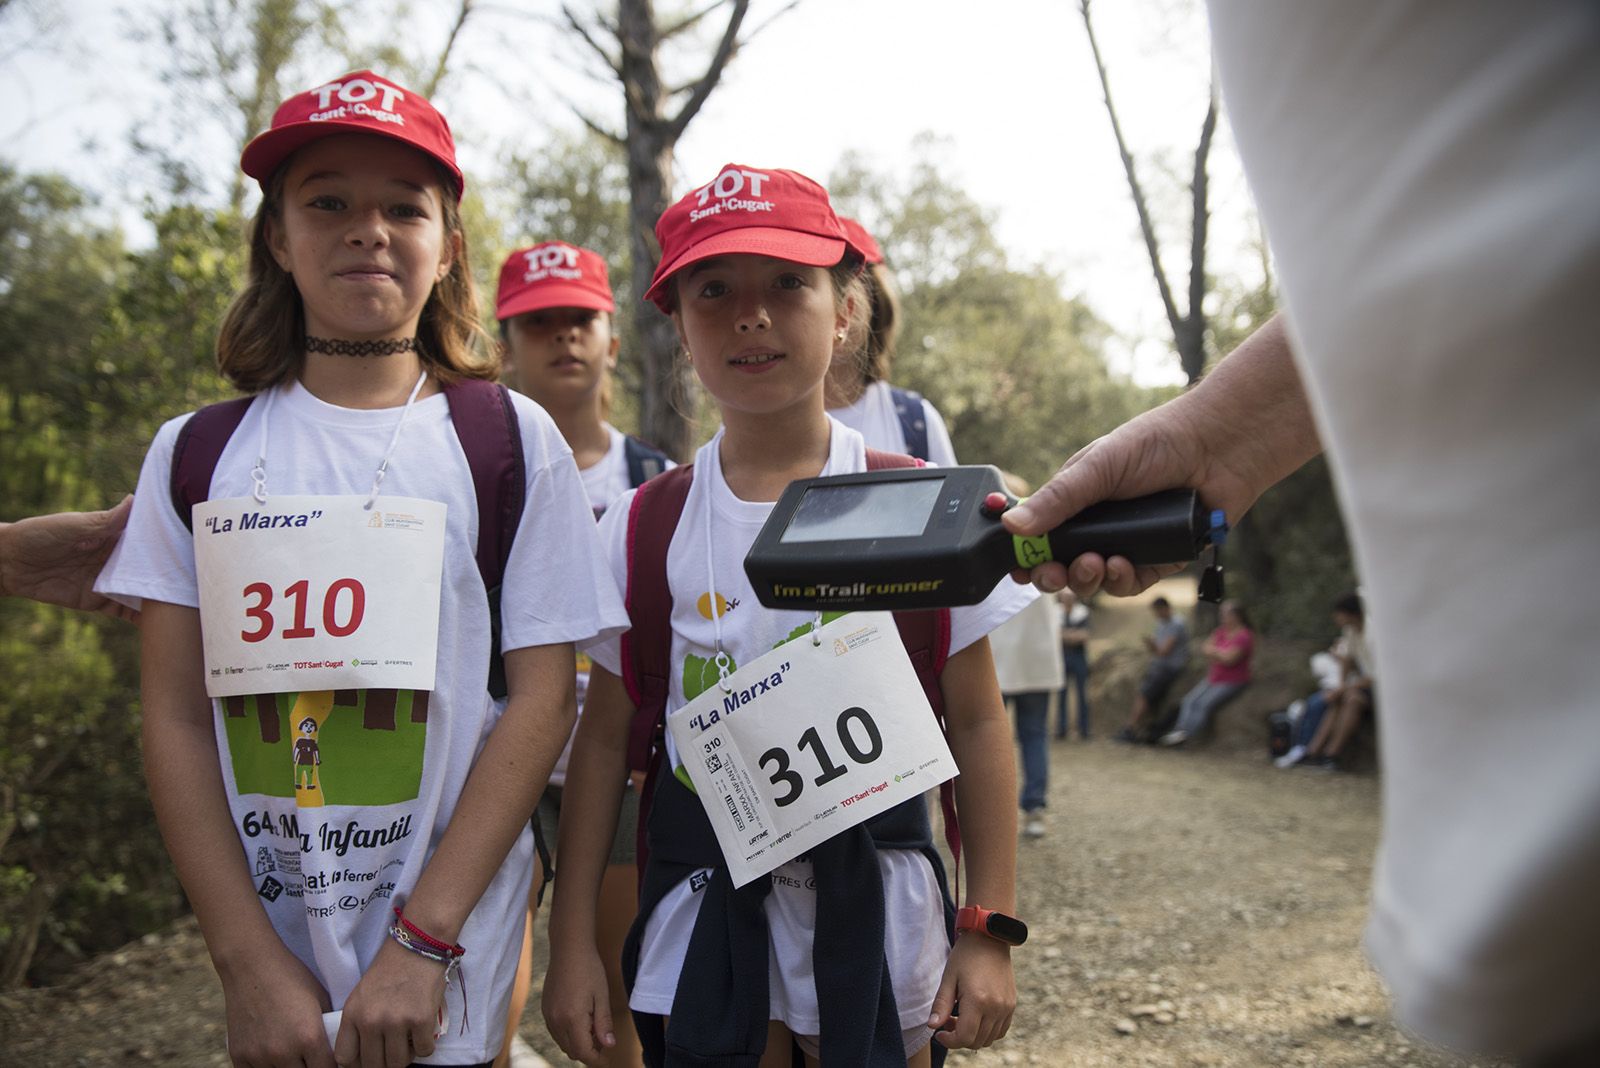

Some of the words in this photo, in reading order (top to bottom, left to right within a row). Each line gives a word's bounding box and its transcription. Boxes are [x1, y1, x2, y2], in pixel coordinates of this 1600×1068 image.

[310, 79, 404, 112] TOT
[309, 106, 346, 122] Sant
[354, 103, 404, 126] Cugat
[695, 169, 769, 207] TOT
[690, 203, 721, 223] Sant
[728, 197, 774, 212] Cugat
[524, 245, 580, 272] TOT
[241, 577, 366, 643] 310
[294, 662, 307, 670] TOT
[308, 661, 322, 669] Sant
[325, 660, 343, 670] Cugat
[704, 737, 721, 753] 310
[758, 706, 883, 808] 310
[723, 759, 741, 794] INFANTIL
[855, 790, 870, 801] Sant
[871, 782, 889, 793] Cugat
[739, 793, 755, 823] MARXA
[319, 814, 412, 857] Infantil
[344, 869, 378, 882] ferrer
